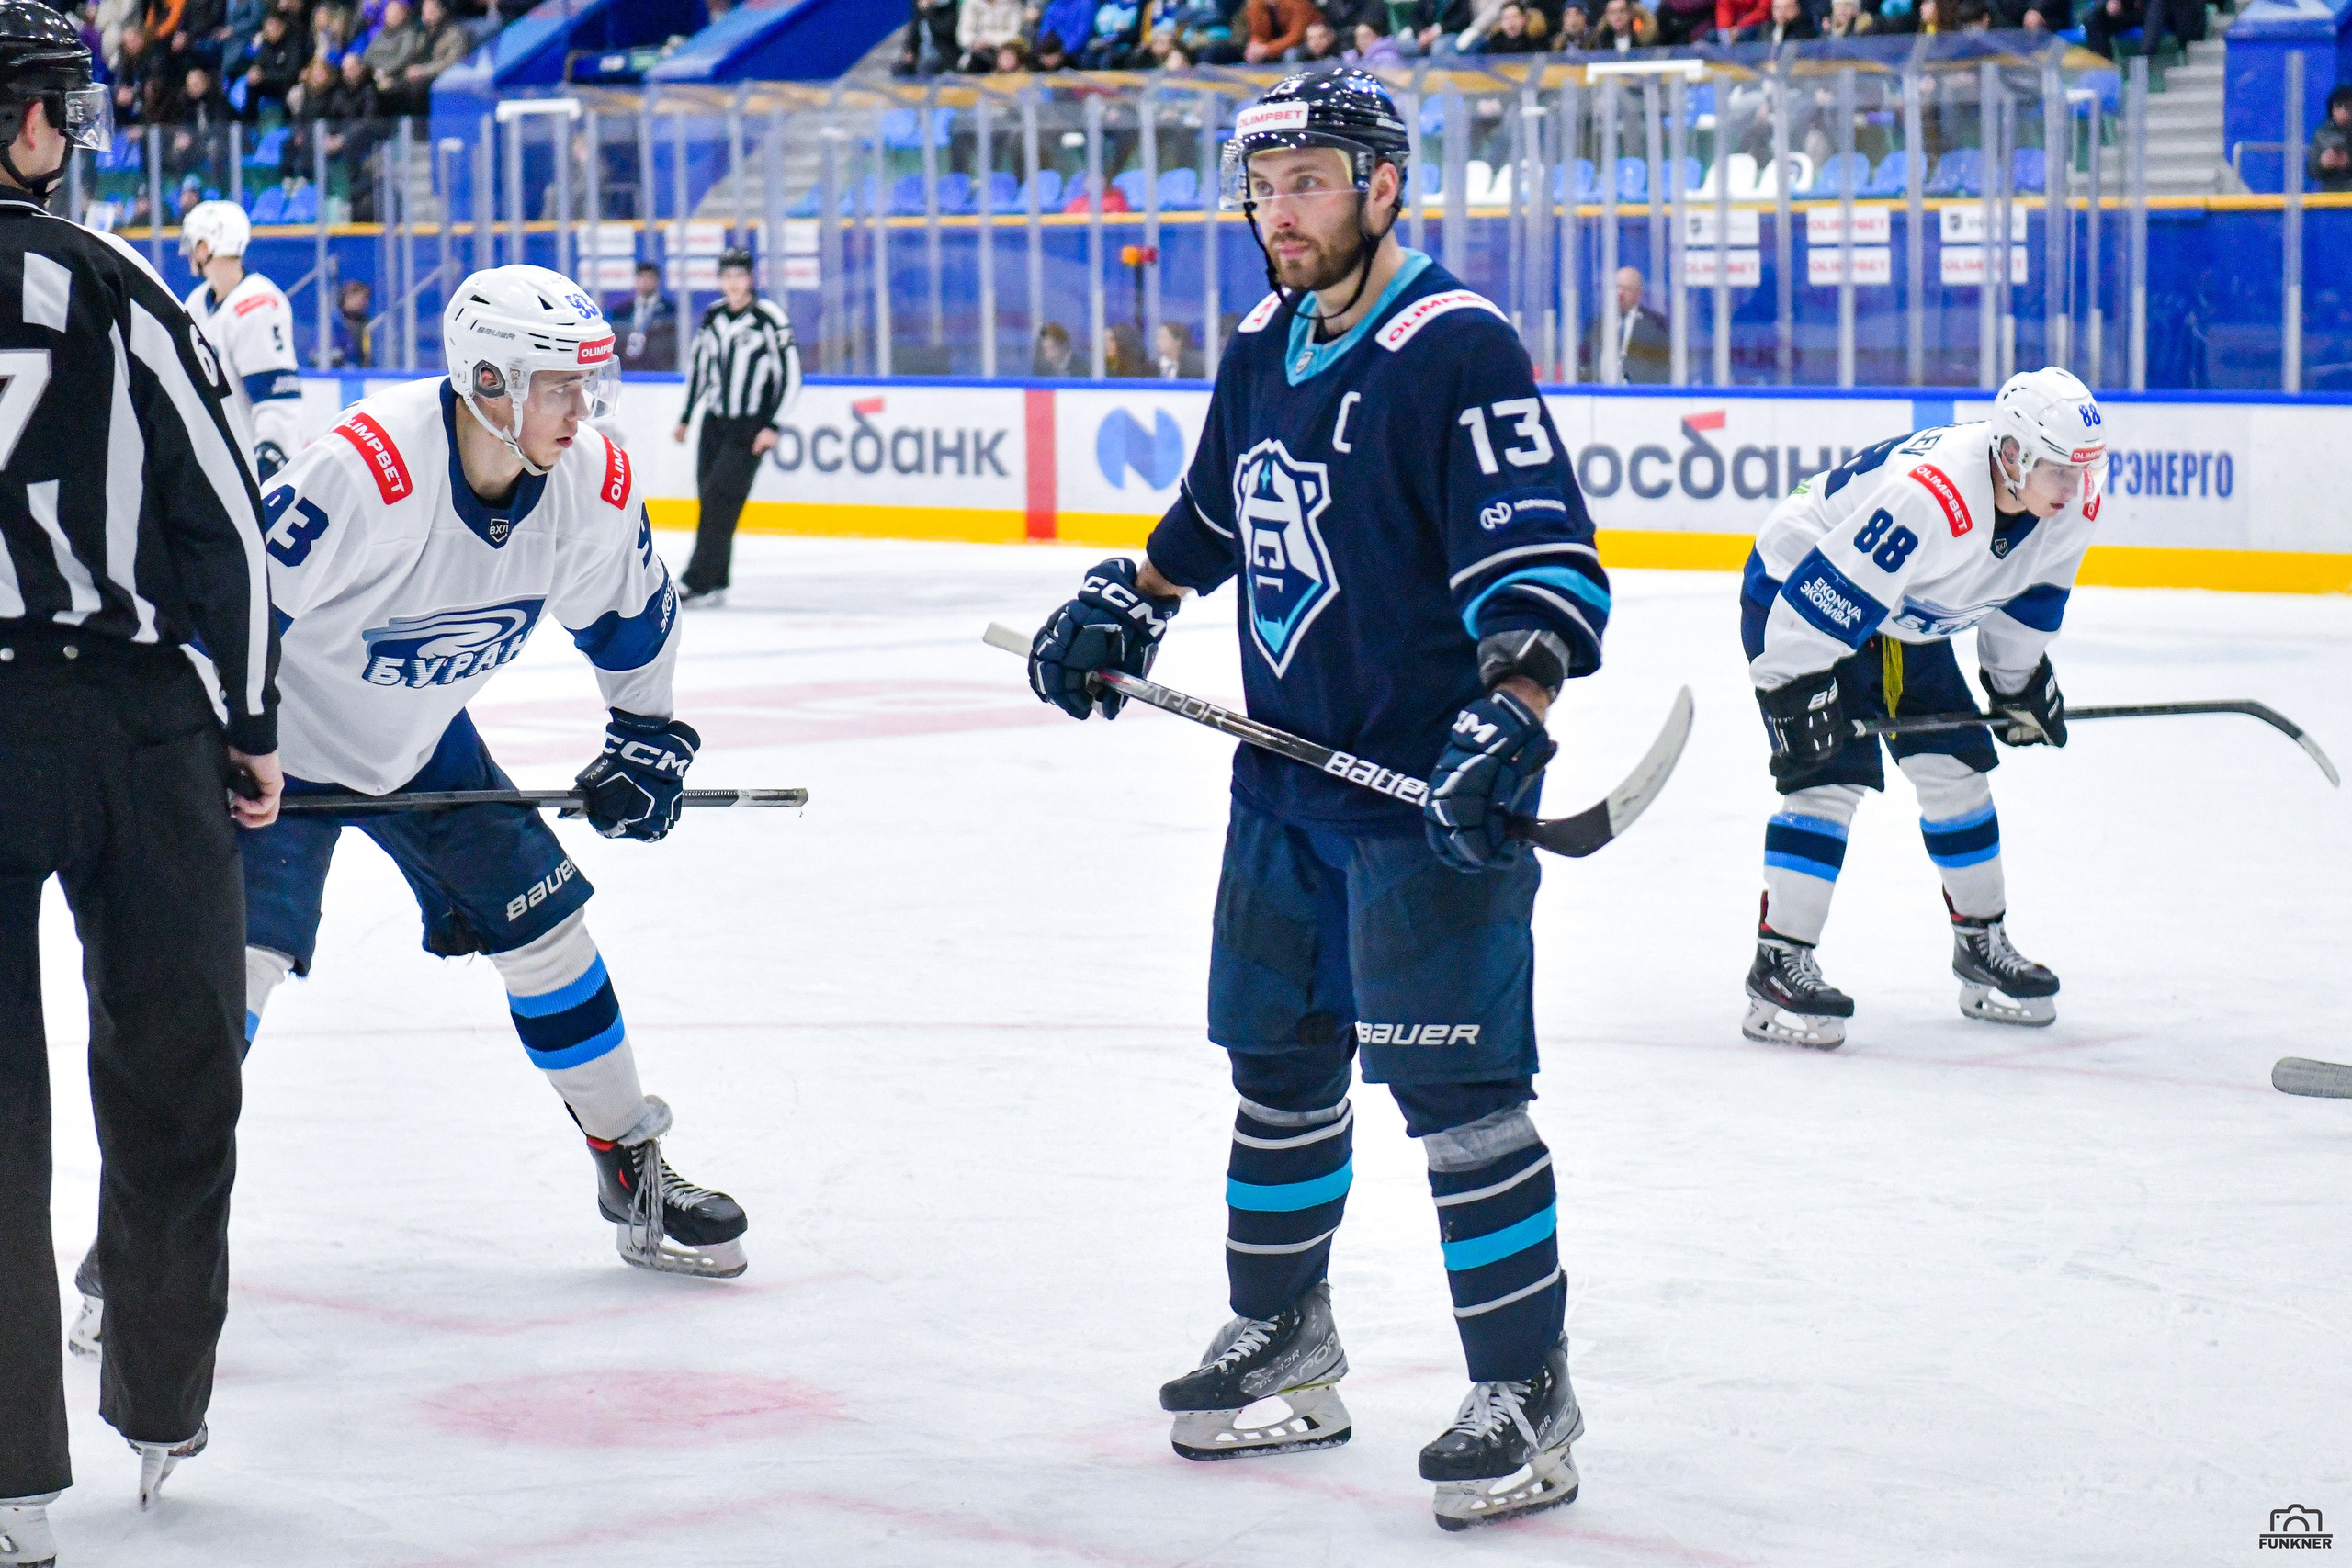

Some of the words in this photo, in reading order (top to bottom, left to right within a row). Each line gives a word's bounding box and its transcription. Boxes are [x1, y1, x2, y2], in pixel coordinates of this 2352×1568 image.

[773, 397, 1010, 478] осбанк
[1332, 391, 1362, 454] C
[1459, 398, 1554, 475] 13
[2078, 402, 2101, 427] 88
[1916, 467, 1969, 531] OLIMPBET
[1853, 507, 1918, 573] 88
[1081, 576, 1168, 637] CCM
[1799, 580, 1851, 630] ЭКОНИВА
[1813, 576, 1862, 623] EKONIVA
[603, 731, 690, 778] CCM
[1355, 1021, 1481, 1046] BAUER
